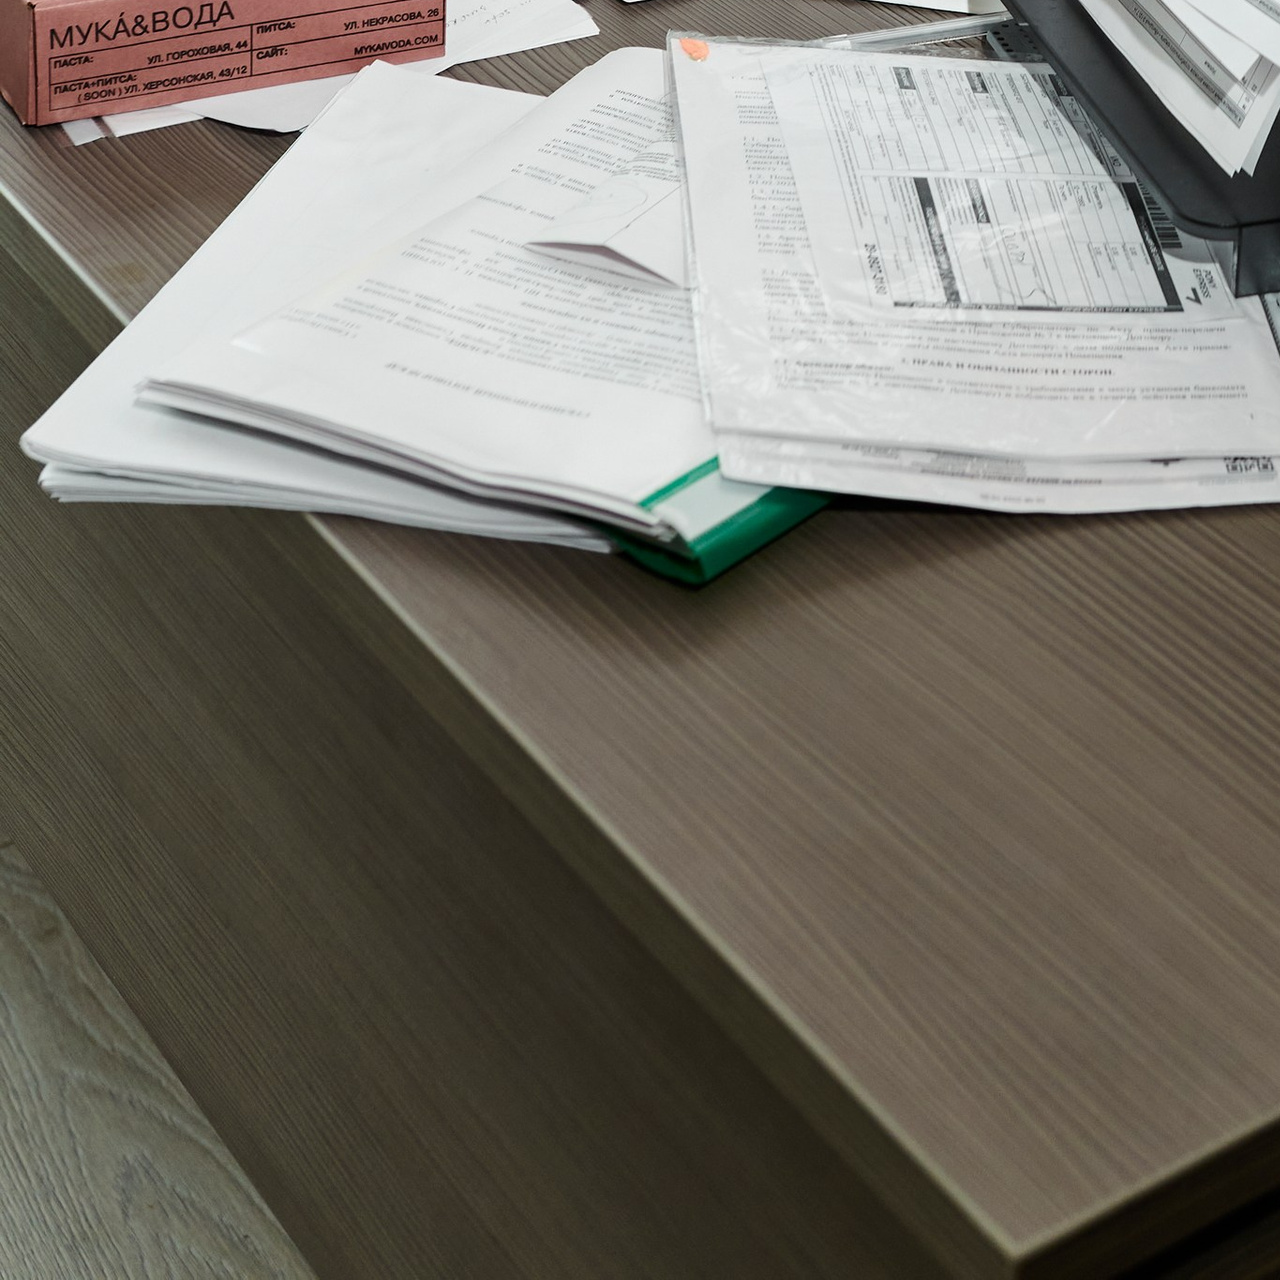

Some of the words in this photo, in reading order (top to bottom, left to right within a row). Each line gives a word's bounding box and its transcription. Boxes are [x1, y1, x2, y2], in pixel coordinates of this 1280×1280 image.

[256, 21, 296, 35] ПИТСА:
[344, 21, 359, 31] УЛ.
[362, 10, 425, 29] НЕКРАСОВА,
[427, 8, 440, 18] 26
[54, 56, 94, 69] ПАСТА:
[147, 53, 164, 65] УЛ.
[166, 42, 234, 62] ГОРОХОВАЯ,
[235, 40, 248, 49] 44
[256, 46, 288, 60] САЙТ:
[143, 71, 217, 91] ХЕРСОНСКАЯ,
[218, 65, 247, 78] 43/12
